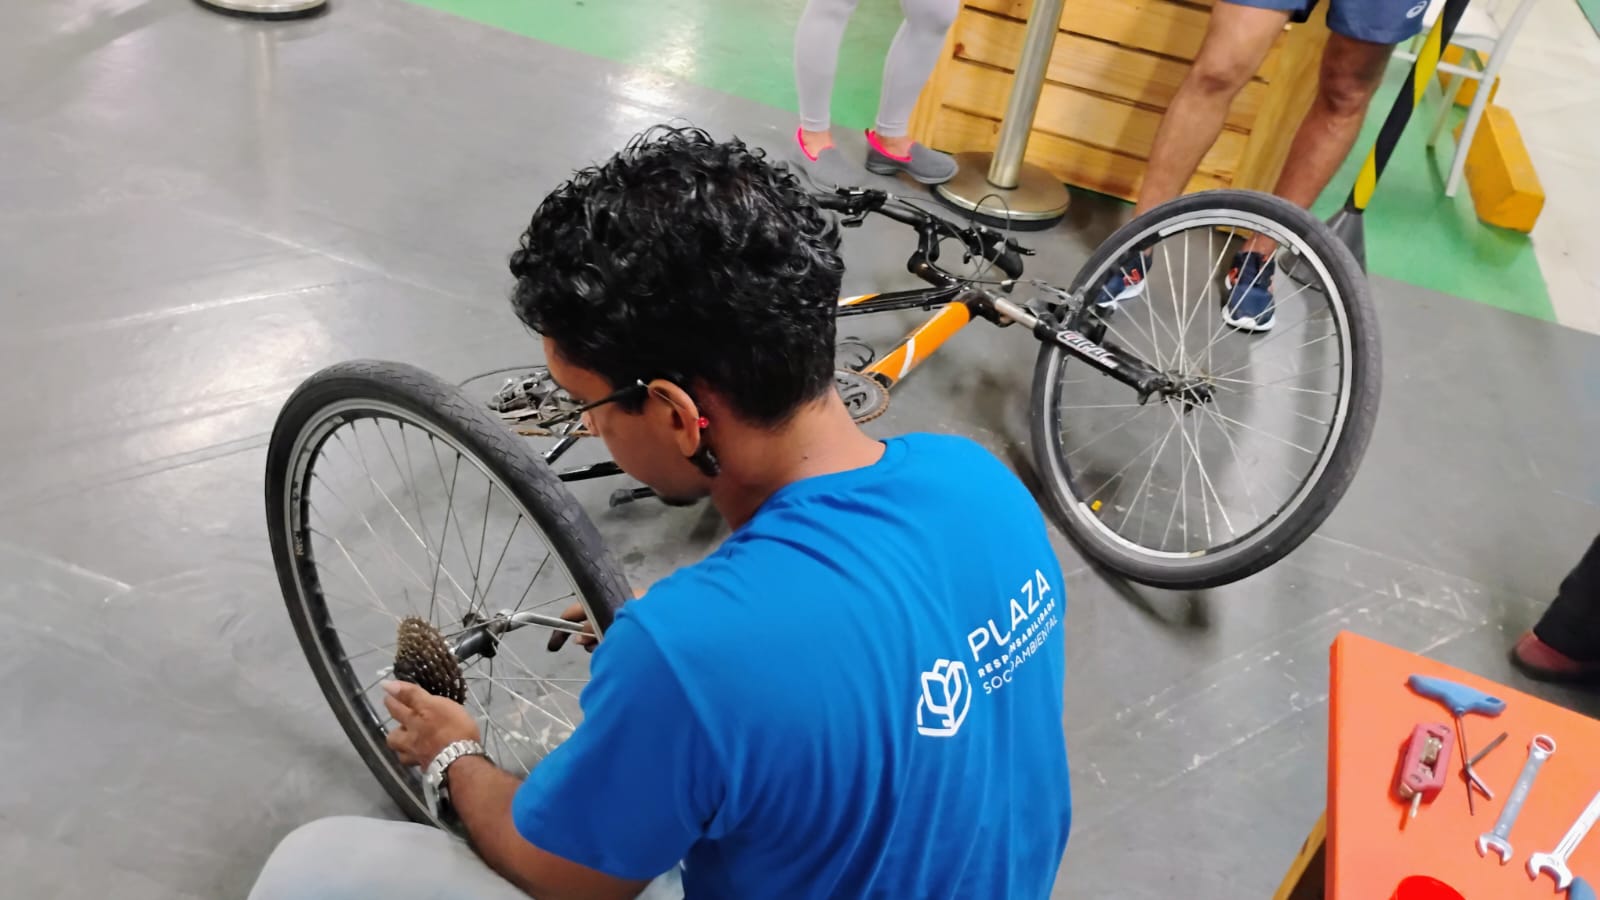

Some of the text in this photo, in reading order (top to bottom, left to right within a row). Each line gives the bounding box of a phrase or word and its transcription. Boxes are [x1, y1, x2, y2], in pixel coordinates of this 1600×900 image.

[967, 568, 1051, 663] PLAZA
[977, 597, 1056, 678] RESPNSABILIDADE
[983, 614, 1058, 694] SOCAMBIENTAL
